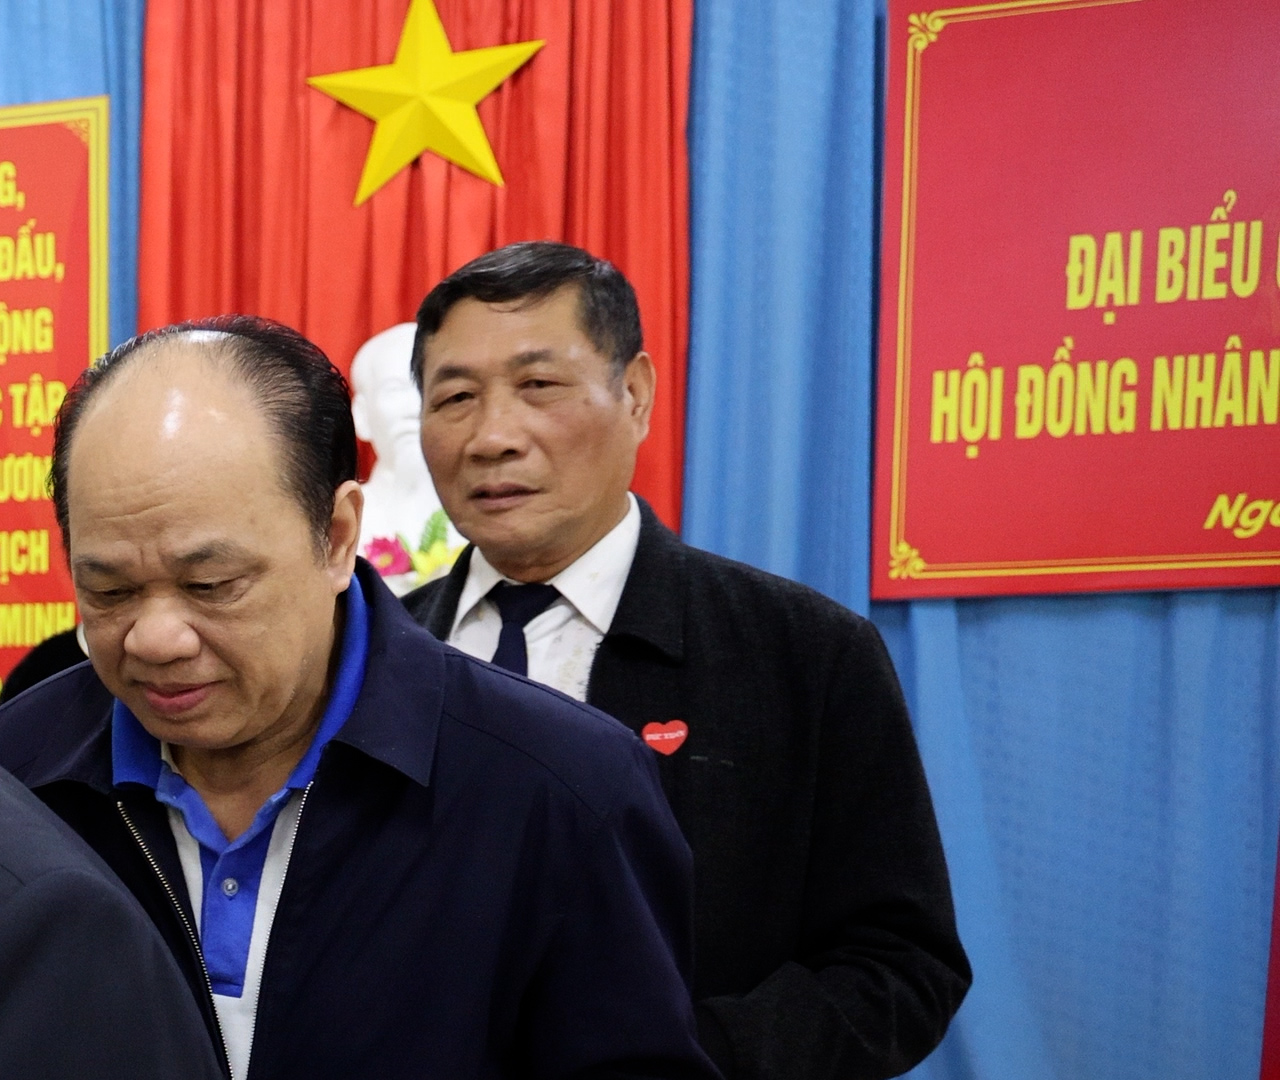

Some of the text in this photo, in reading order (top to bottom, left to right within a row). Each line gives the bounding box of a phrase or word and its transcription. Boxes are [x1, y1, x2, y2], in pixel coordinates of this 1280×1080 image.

[1066, 230, 1142, 324] ĐẠI
[1156, 190, 1262, 302] BIỂU
[8, 373, 67, 436] TẬP
[931, 336, 1280, 458] HỘI ĐỒNG NHÂN
